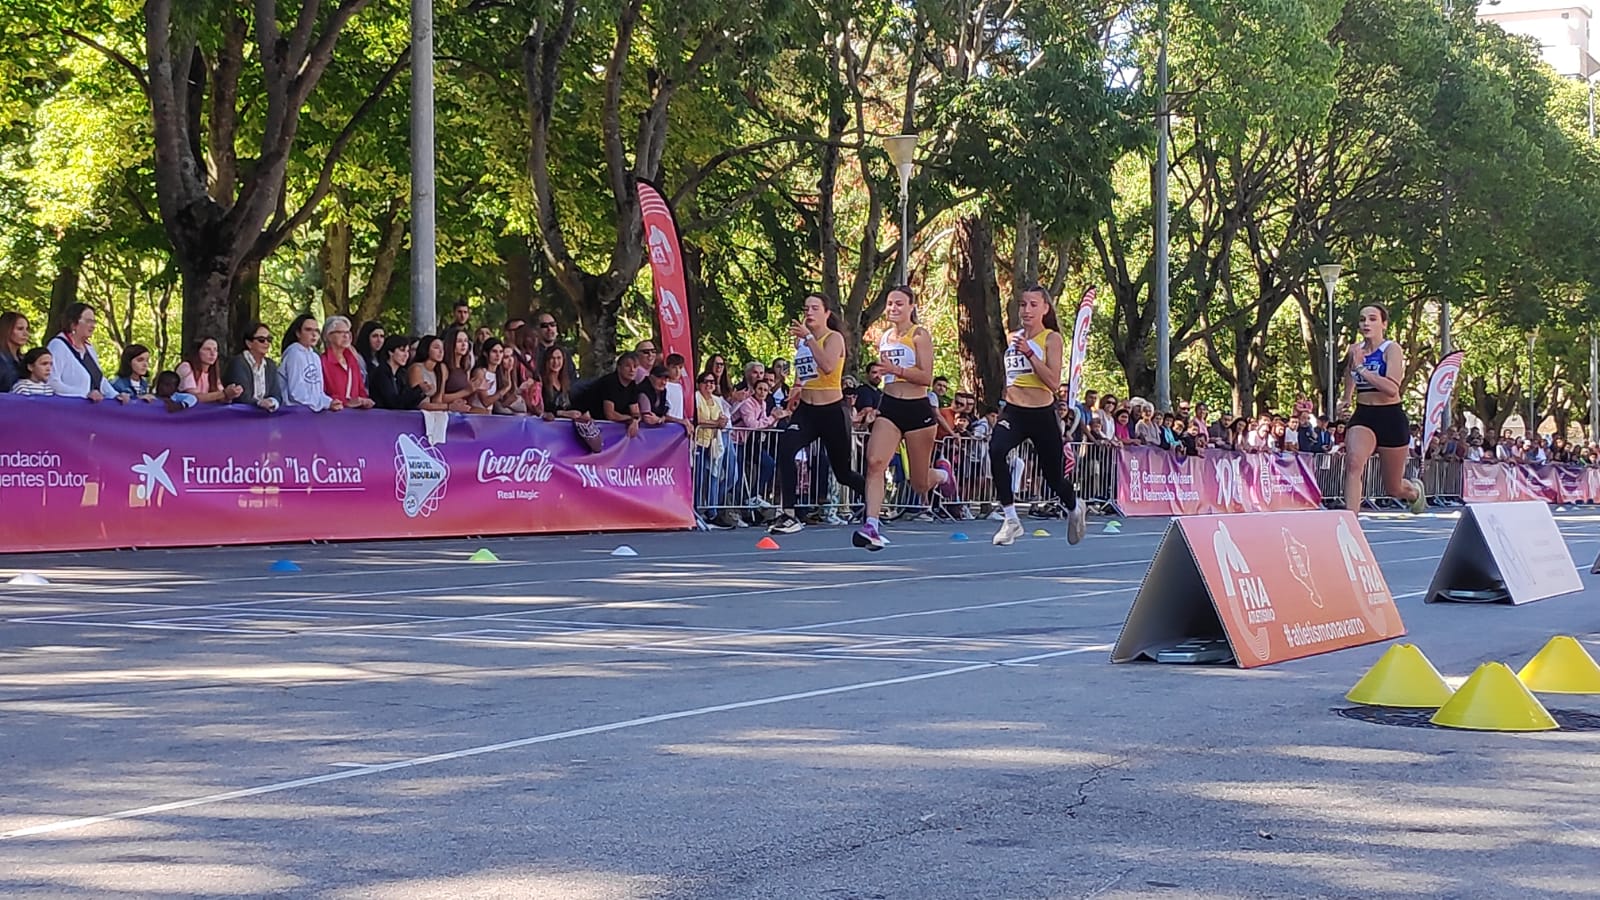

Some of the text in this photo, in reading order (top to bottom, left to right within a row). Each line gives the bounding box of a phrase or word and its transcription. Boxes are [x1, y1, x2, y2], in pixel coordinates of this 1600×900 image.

[1007, 357, 1025, 368] 331
[0, 450, 61, 467] ndación
[182, 456, 284, 484] Fundación
[477, 447, 555, 483] Coca-Cola
[0, 470, 89, 487] entes Dutor
[606, 464, 643, 487] IRUÑA
[645, 467, 676, 486] PARK
[497, 490, 540, 500] Real Magic
[1358, 565, 1385, 593] FNA
[1238, 576, 1272, 610] FNA
[1283, 616, 1366, 648] #atletismonavarro
